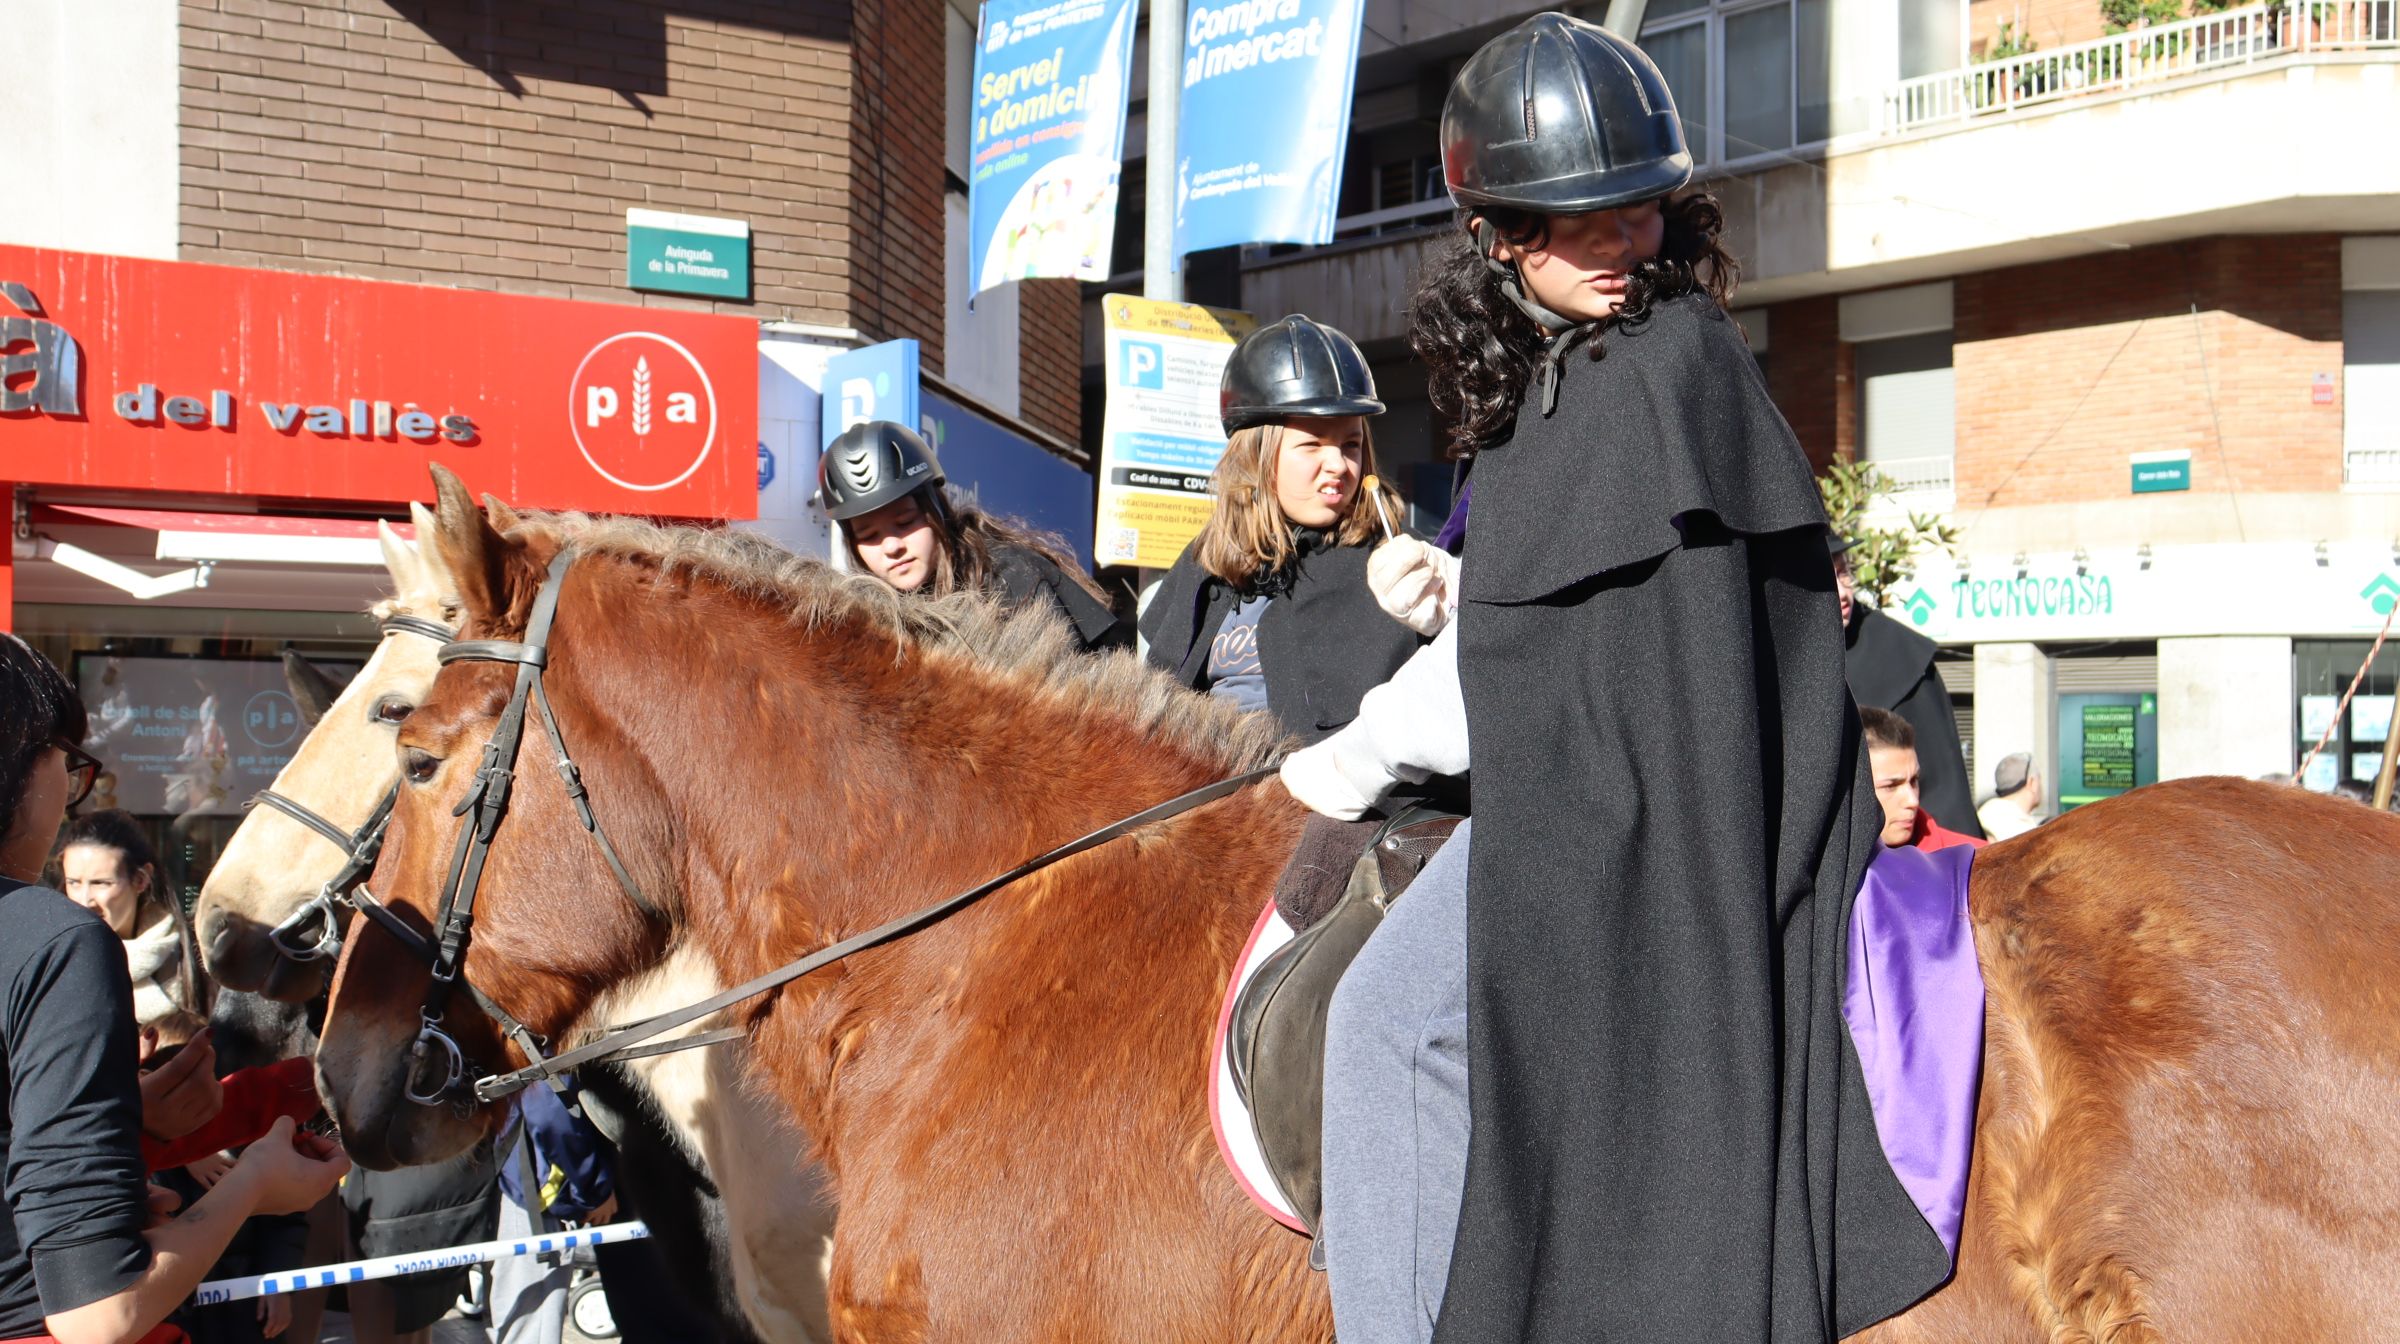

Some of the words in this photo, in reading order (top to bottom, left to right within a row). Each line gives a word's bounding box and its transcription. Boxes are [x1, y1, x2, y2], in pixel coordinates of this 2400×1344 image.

[1189, 0, 1300, 47] Compra
[1204, 16, 1323, 79] mercat
[979, 46, 1064, 108] Servei
[648, 259, 662, 272] de
[665, 261, 676, 273] la
[677, 262, 729, 279] Primavera
[665, 244, 714, 262] Avinguda
[1128, 345, 1156, 385] P
[114, 384, 230, 427] del
[260, 399, 474, 442] vallès
[1130, 472, 1148, 483] Codi
[1148, 474, 1159, 484] de
[1116, 497, 1182, 511] Estacionament
[1951, 575, 2112, 618] TECNOCASA
